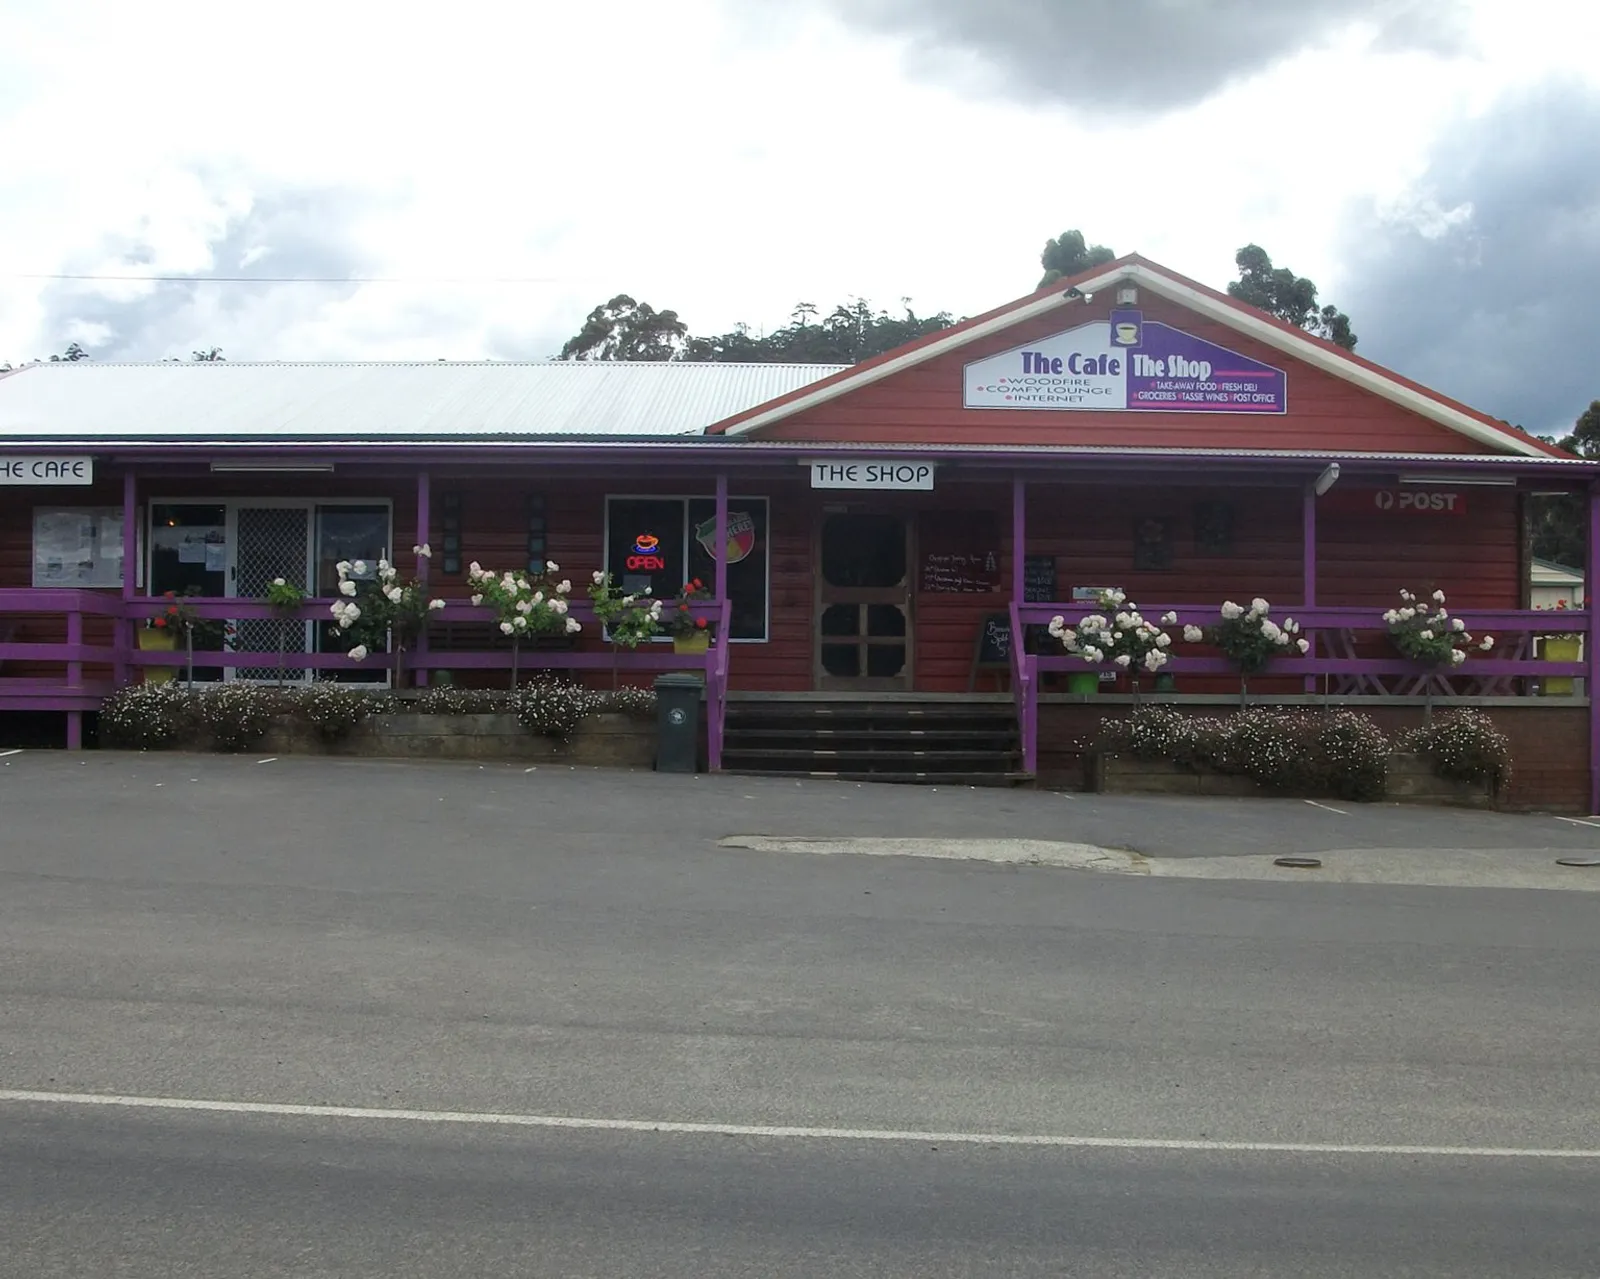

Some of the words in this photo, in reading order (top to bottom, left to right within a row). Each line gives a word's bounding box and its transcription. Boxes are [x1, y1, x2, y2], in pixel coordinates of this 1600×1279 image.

[1021, 352, 1063, 375] The
[1068, 352, 1121, 376] Cafe
[1133, 354, 1165, 377] The
[1167, 355, 1212, 381] Shop
[1008, 377, 1091, 386] WOODFIRE
[1156, 381, 1194, 390] TAKE-AWAY
[1196, 382, 1217, 391] FOOD
[1222, 382, 1243, 391] FRESH
[1243, 383, 1258, 391] DELI
[986, 385, 1042, 394] COMFY
[1047, 386, 1112, 395] LOUNGE
[1138, 391, 1177, 400] GROCERIES
[1182, 392, 1204, 401] TASSIE
[1205, 393, 1228, 402] WINES
[1233, 393, 1251, 402] POST
[1251, 393, 1276, 403] OFFICE
[1014, 395, 1084, 403] INTERNET
[0, 461, 24, 478] HE
[31, 461, 84, 478] CAFE
[816, 464, 858, 482] THE
[866, 465, 930, 483] SHOP
[1399, 492, 1458, 511] POST
[626, 555, 665, 570] OPEN
